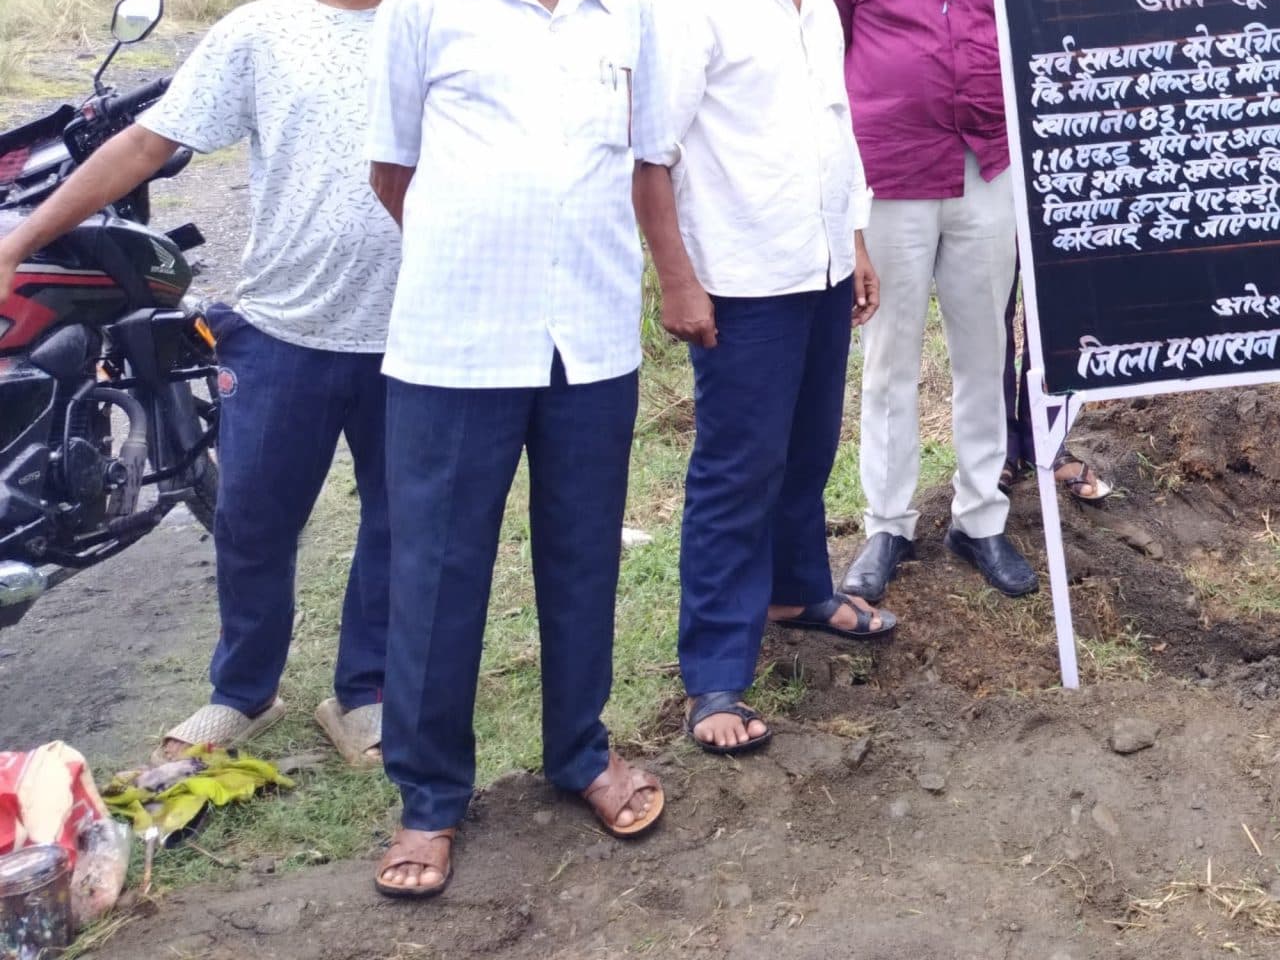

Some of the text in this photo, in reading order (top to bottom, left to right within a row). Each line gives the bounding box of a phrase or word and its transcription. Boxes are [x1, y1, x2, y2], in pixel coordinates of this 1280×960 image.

[1029, 35, 1075, 76] सर्व
[1078, 41, 1178, 74] साधारण
[1182, 24, 1216, 62] को
[1031, 75, 1064, 108] कि
[1068, 72, 1134, 102] मौजा
[1032, 111, 1101, 138] खाता
[1185, 93, 1246, 122] प्लॉट
[1032, 147, 1074, 173] 1.16
[1139, 128, 1191, 160] भूमि
[1190, 123, 1229, 154] गैर
[1033, 172, 1087, 195] उक्त
[1092, 165, 1147, 191] भूमि
[1147, 157, 1181, 184] की
[1042, 190, 1122, 225] निर्माण
[1129, 183, 1194, 216] करने
[1195, 189, 1227, 212] पर
[1149, 214, 1190, 242] की
[1077, 335, 1163, 379] जिला
